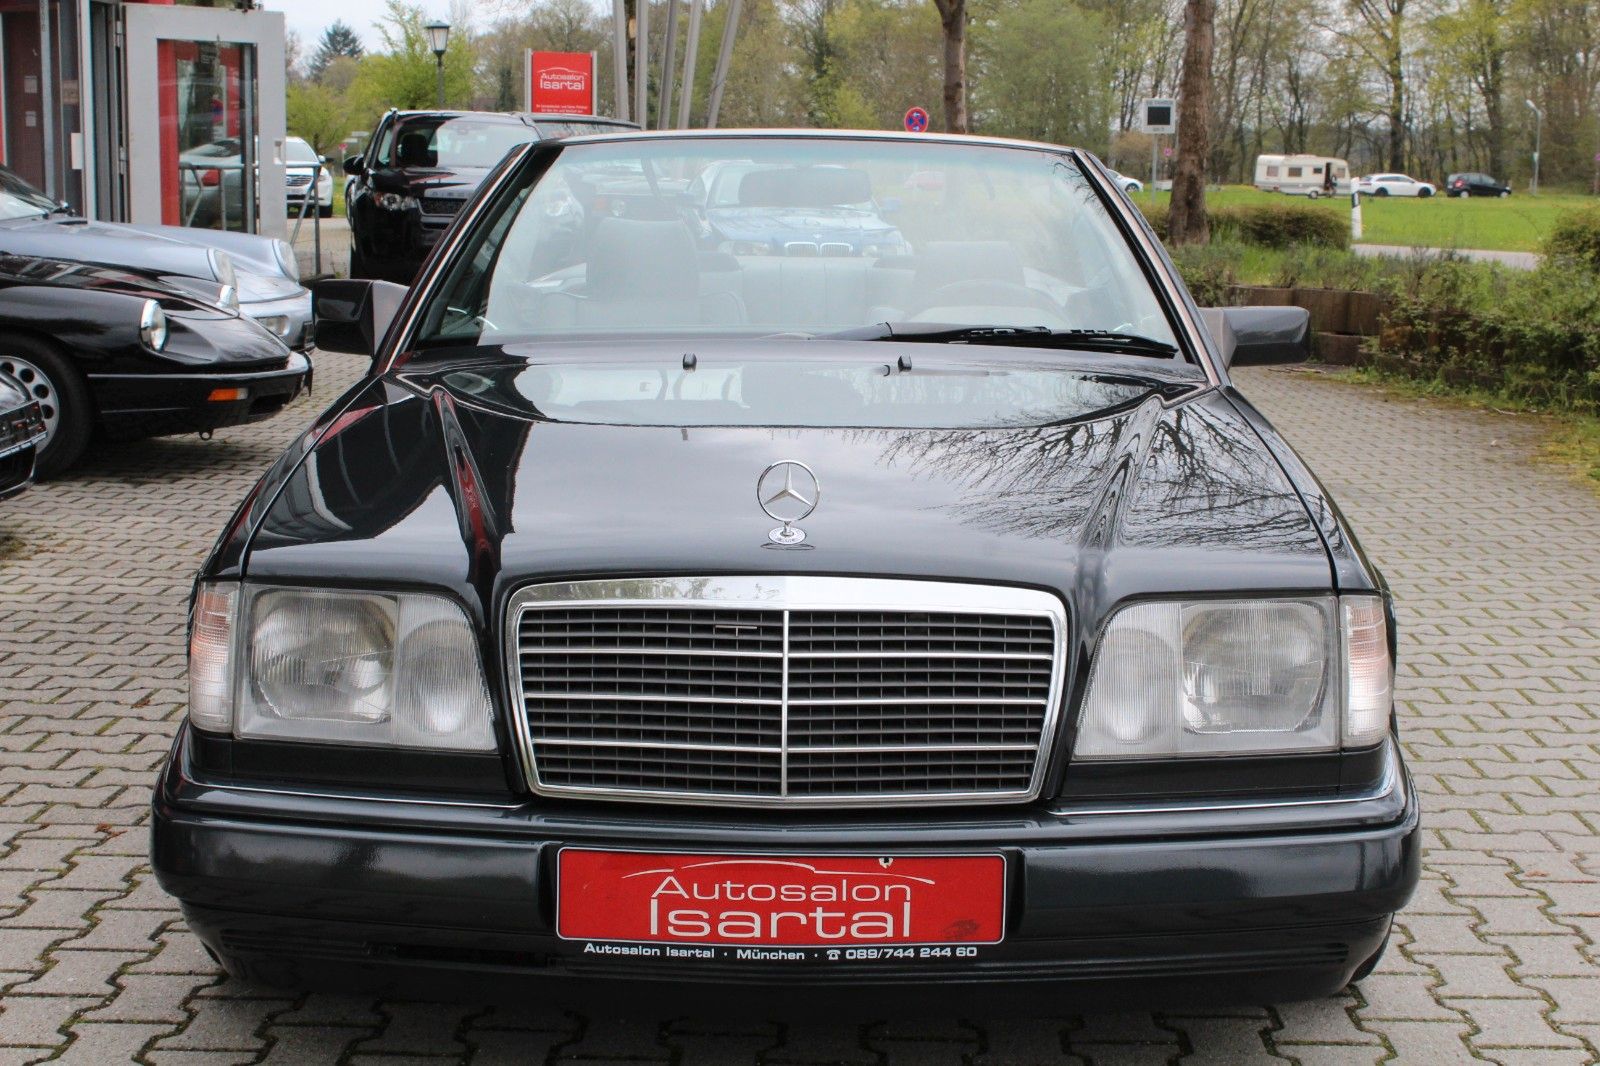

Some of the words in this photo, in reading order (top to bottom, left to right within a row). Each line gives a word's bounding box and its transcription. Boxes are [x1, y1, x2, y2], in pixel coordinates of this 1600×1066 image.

[540, 79, 585, 90] Isartal
[651, 876, 911, 902] Autosalon
[650, 898, 911, 938] Isartal
[584, 943, 661, 956] Autosalon
[666, 946, 715, 958] Isartal
[736, 948, 805, 960] München
[845, 948, 914, 959] 089/744
[919, 947, 951, 958] 244
[955, 946, 977, 957] 60
